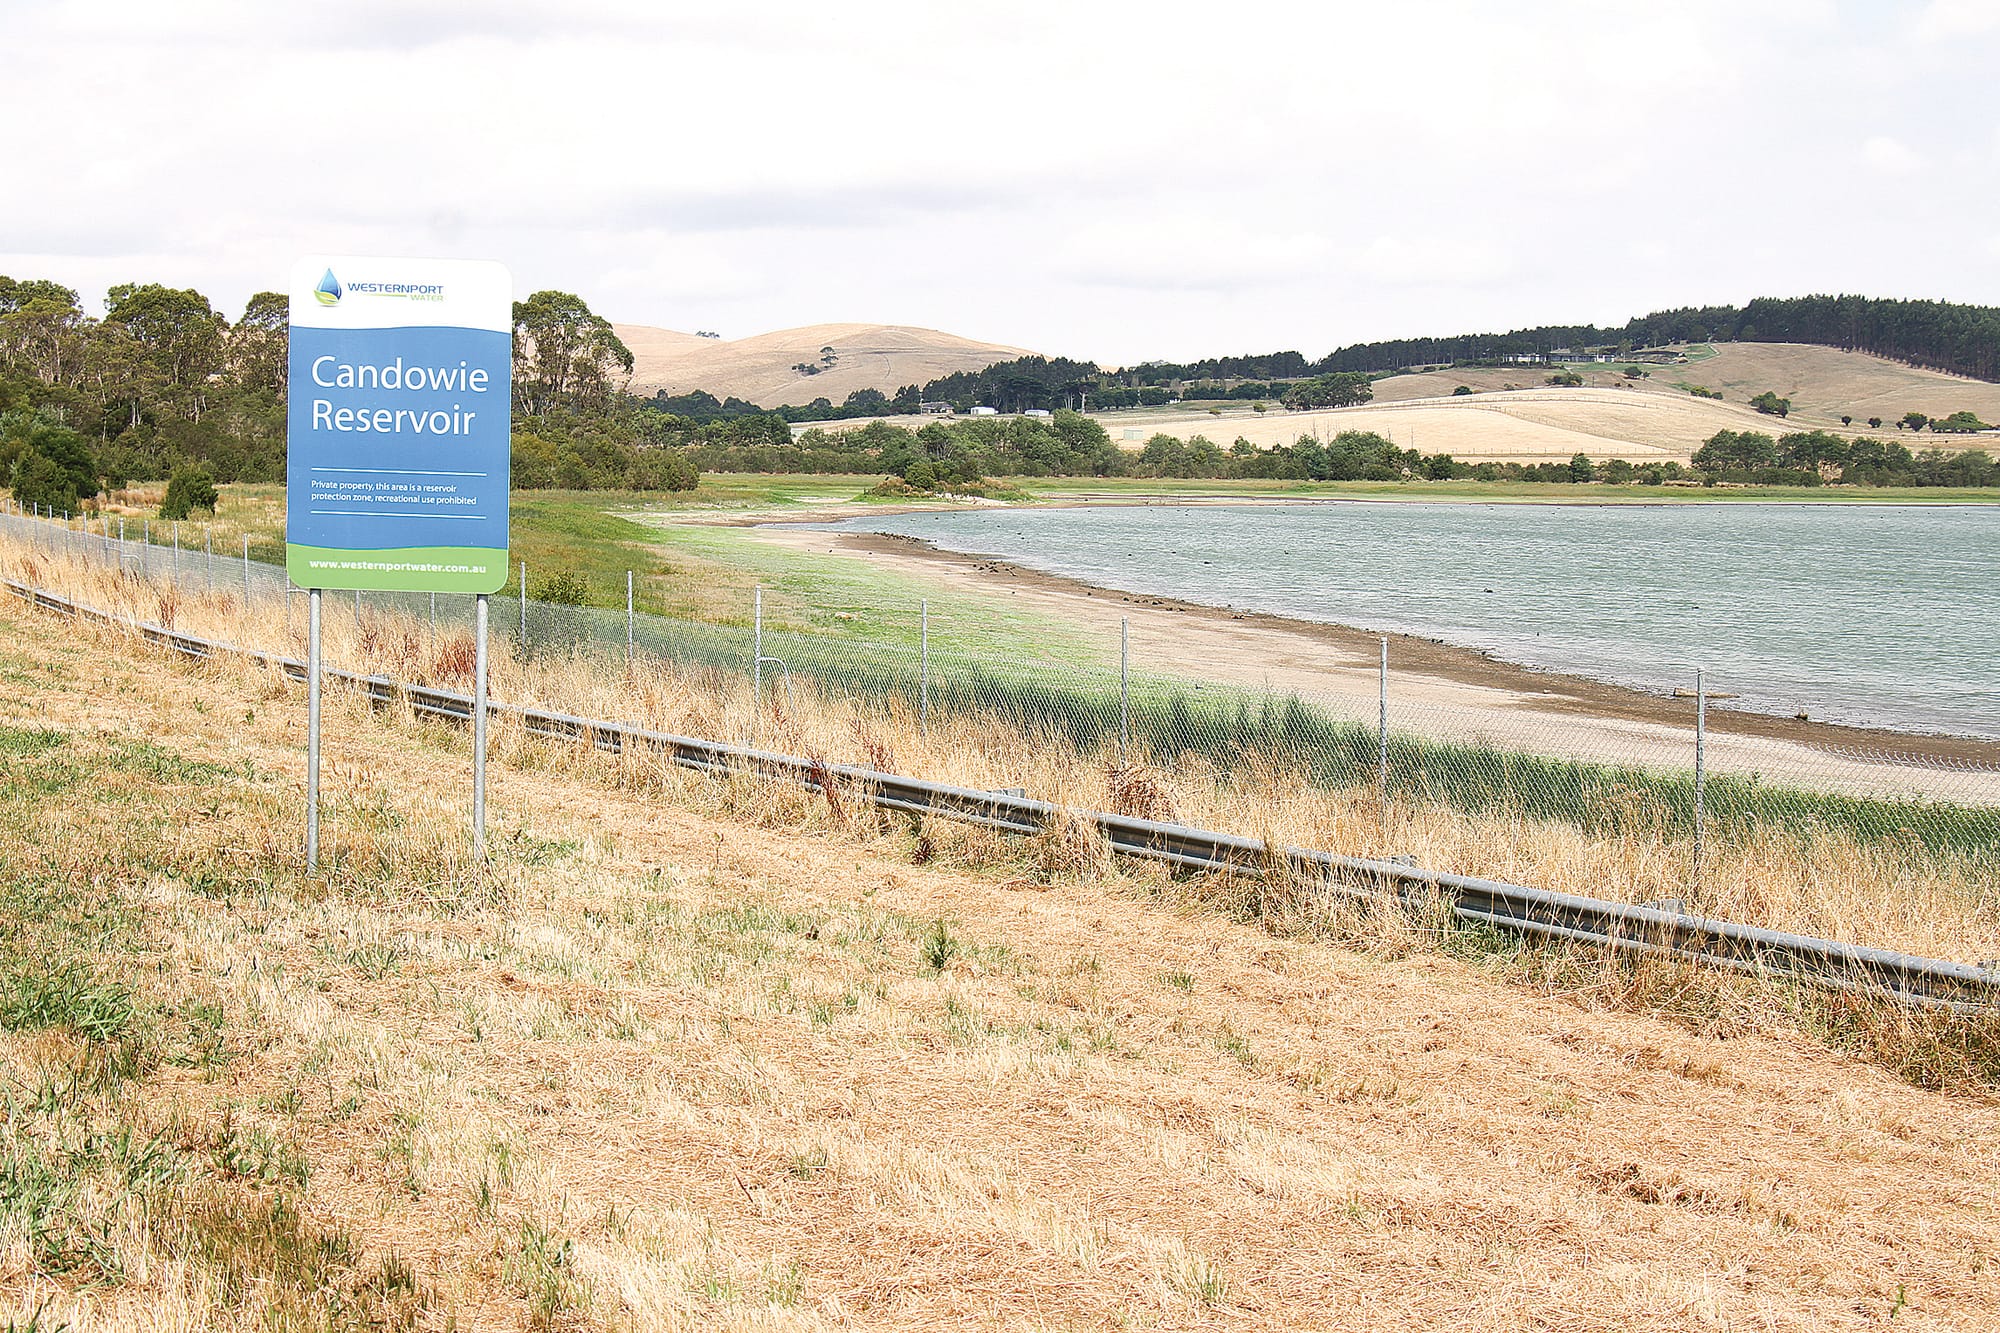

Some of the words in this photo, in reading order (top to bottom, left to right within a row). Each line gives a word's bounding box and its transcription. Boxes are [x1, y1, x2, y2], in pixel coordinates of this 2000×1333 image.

[347, 282, 444, 294] WESTERNPORT
[311, 355, 489, 392] Candowie
[312, 399, 476, 435] Reservoir
[311, 480, 338, 489] Private
[340, 483, 375, 492] property,
[376, 483, 390, 491] this
[423, 485, 457, 493] reservoir
[311, 493, 352, 501] protection
[375, 494, 420, 503] recreational
[436, 496, 477, 505] prohibited
[309, 560, 487, 574] www.westernportwater.com.au
